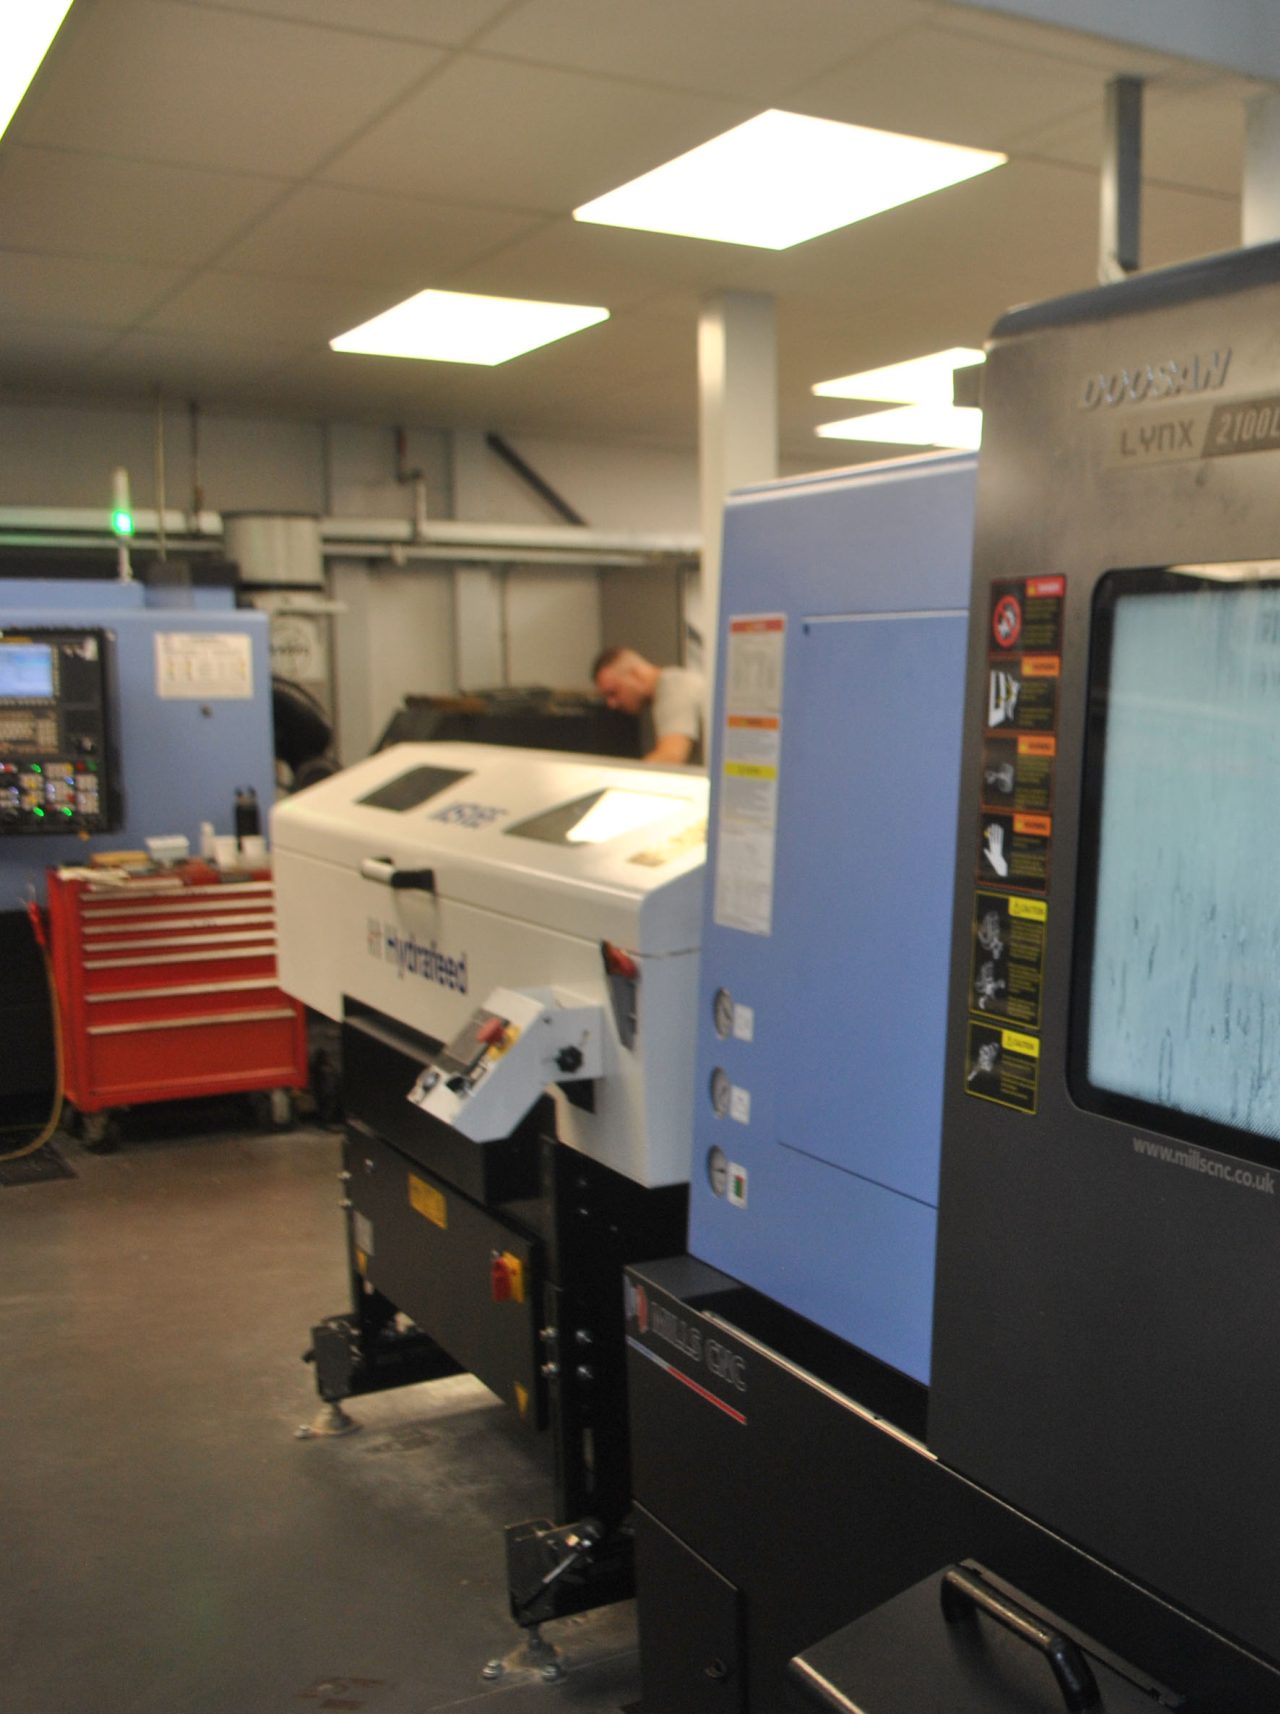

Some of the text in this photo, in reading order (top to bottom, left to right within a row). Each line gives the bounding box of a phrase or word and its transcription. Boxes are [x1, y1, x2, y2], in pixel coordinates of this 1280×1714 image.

[1081, 347, 1232, 412] DOOSAN
[384, 921, 468, 995] Hydrafeed
[1132, 1136, 1276, 1194] www.millscnc.co.uk
